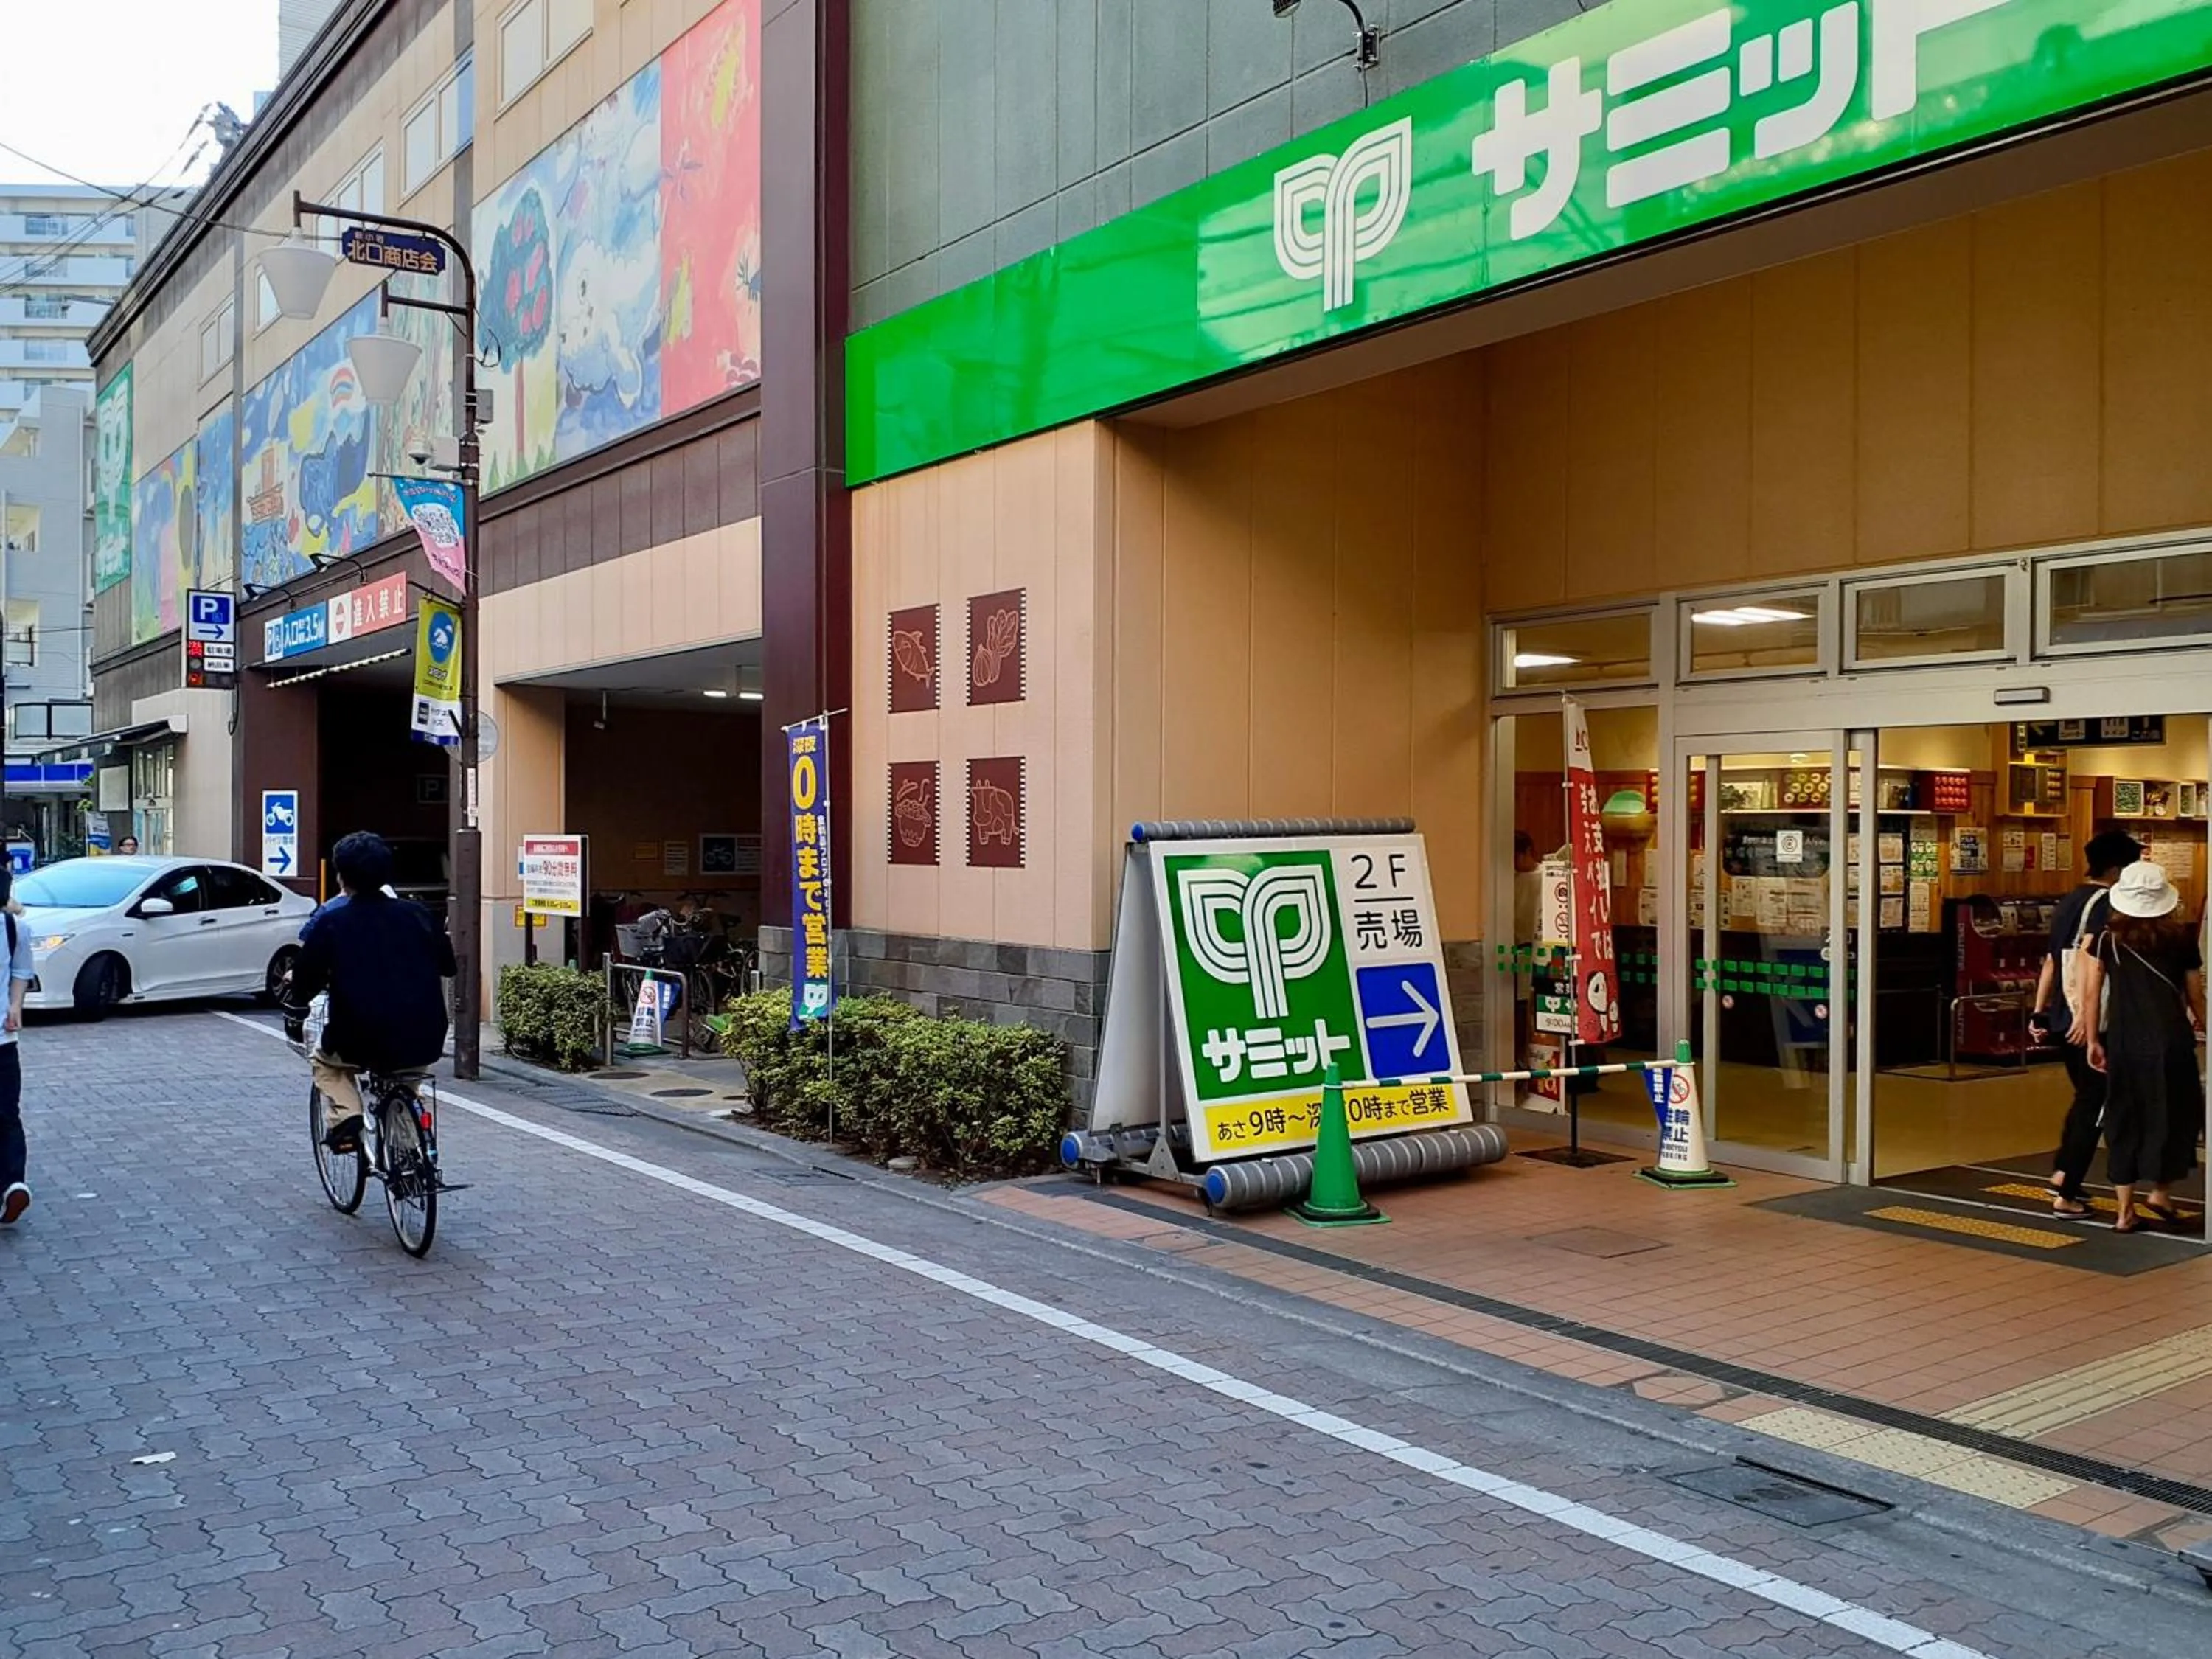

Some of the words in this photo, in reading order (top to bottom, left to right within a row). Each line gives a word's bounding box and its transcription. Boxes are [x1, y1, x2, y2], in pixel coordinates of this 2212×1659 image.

[348, 240, 437, 272] 北口商店会
[200, 598, 218, 620] P
[353, 583, 403, 627] 進入禁止
[284, 620, 299, 650] 入口
[1350, 854, 1405, 889] 2F
[1579, 782, 1601, 960] 楽天ペイで
[1587, 784, 1614, 960] お支払いは
[1354, 908, 1423, 950] 売場
[1202, 1018, 1352, 1083] サミット
[1217, 1085, 1450, 1141] あさ9時〜深0時まで営業
